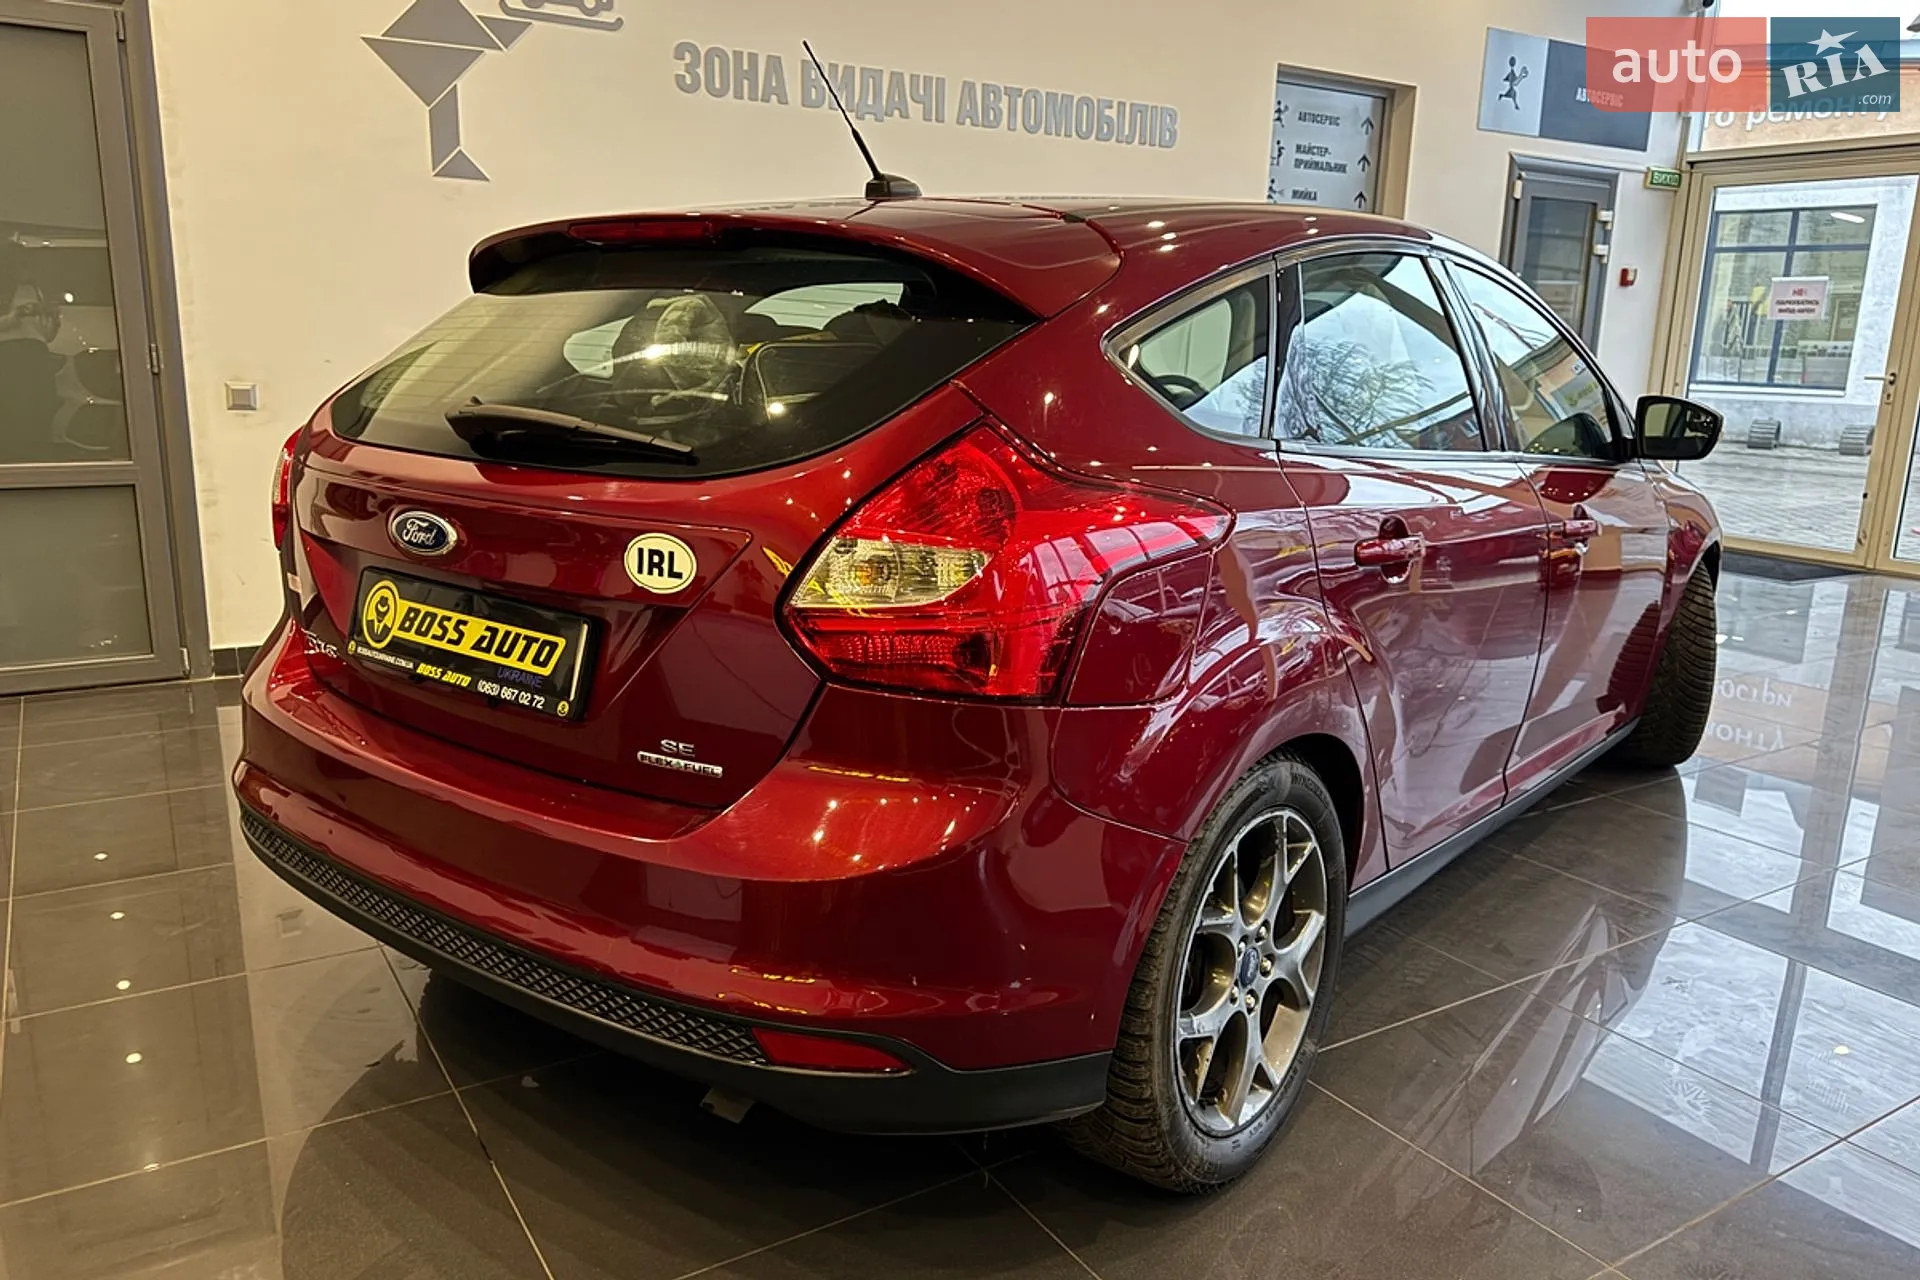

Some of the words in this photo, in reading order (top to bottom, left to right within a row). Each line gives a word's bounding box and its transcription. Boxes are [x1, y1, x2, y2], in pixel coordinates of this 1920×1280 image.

[672, 41, 789, 105] ЗОНА
[800, 59, 946, 123] ВИДАЧІ
[956, 79, 1178, 149] АВТОМОБІЛІВ
[1295, 142, 1332, 157] МАЙСТЕР-
[401, 518, 436, 546] Ford
[636, 547, 684, 580] IRL
[399, 606, 468, 647] BOSS
[471, 625, 559, 667] AUTO
[416, 663, 443, 680] BOSS
[442, 670, 472, 688] AUTO
[496, 666, 545, 689] UKRAINE
[477, 679, 500, 697] (063)
[500, 685, 517, 701] 667
[518, 691, 531, 705] 02
[531, 694, 545, 710] 72
[660, 739, 696, 758] SE
